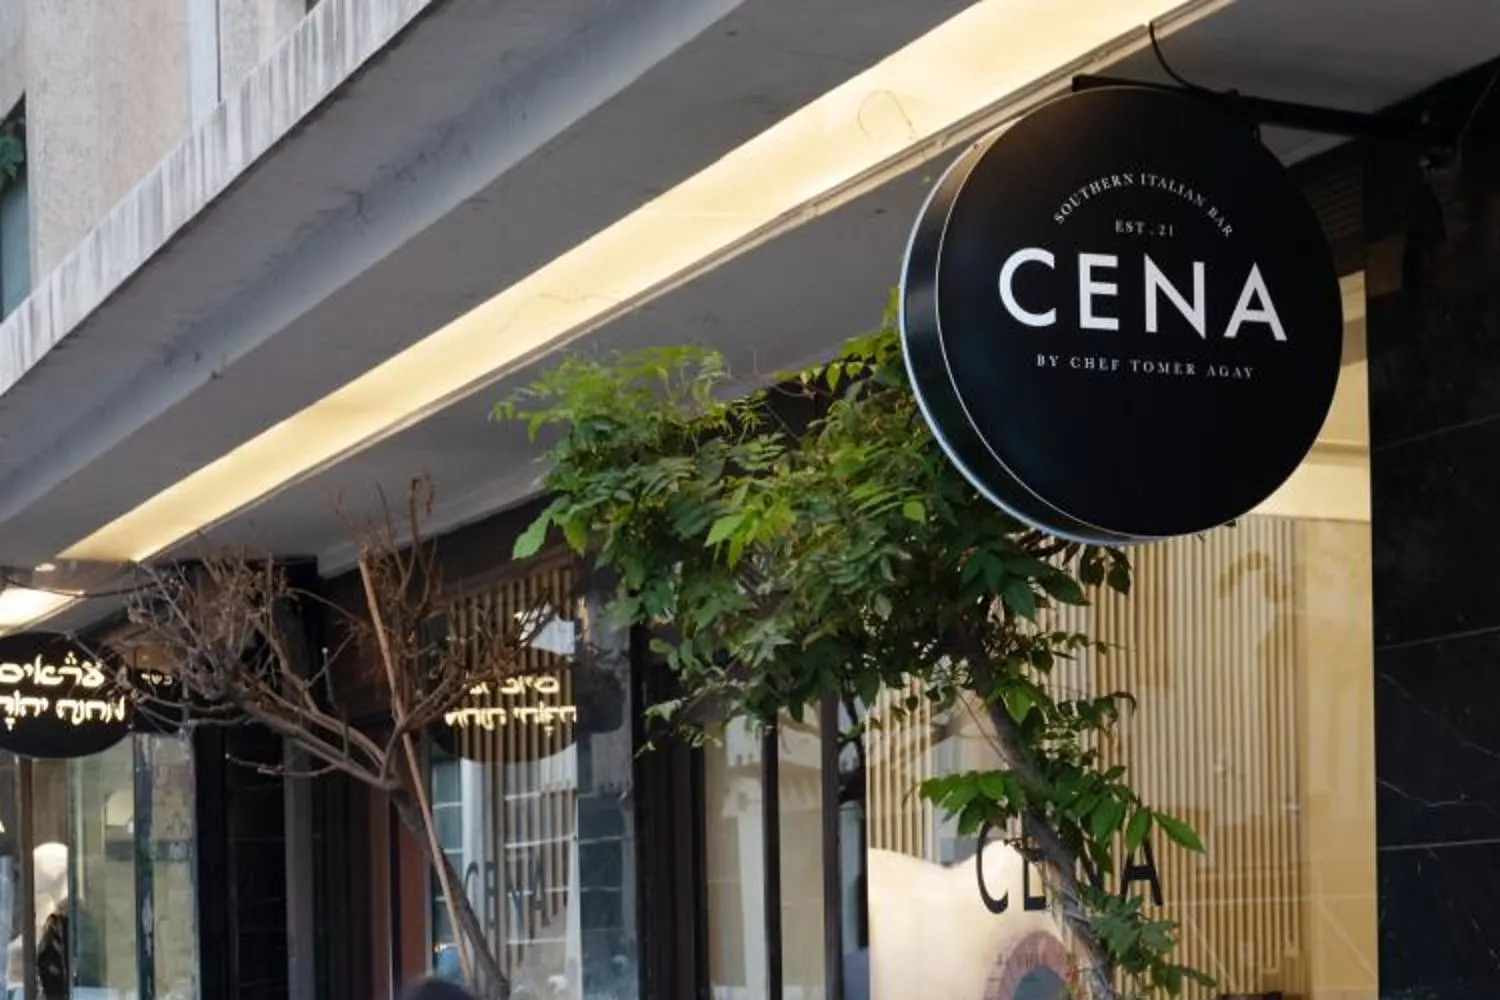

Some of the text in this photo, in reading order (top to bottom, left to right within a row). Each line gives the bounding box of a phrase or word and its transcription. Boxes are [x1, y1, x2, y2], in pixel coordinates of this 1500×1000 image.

[1053, 172, 1233, 238] SOUTHERN ITALIAN BAR
[998, 247, 1288, 341] CENA
[1036, 353, 1253, 380] BY CHEF TOMER AGAY
[976, 818, 1163, 914] CA
